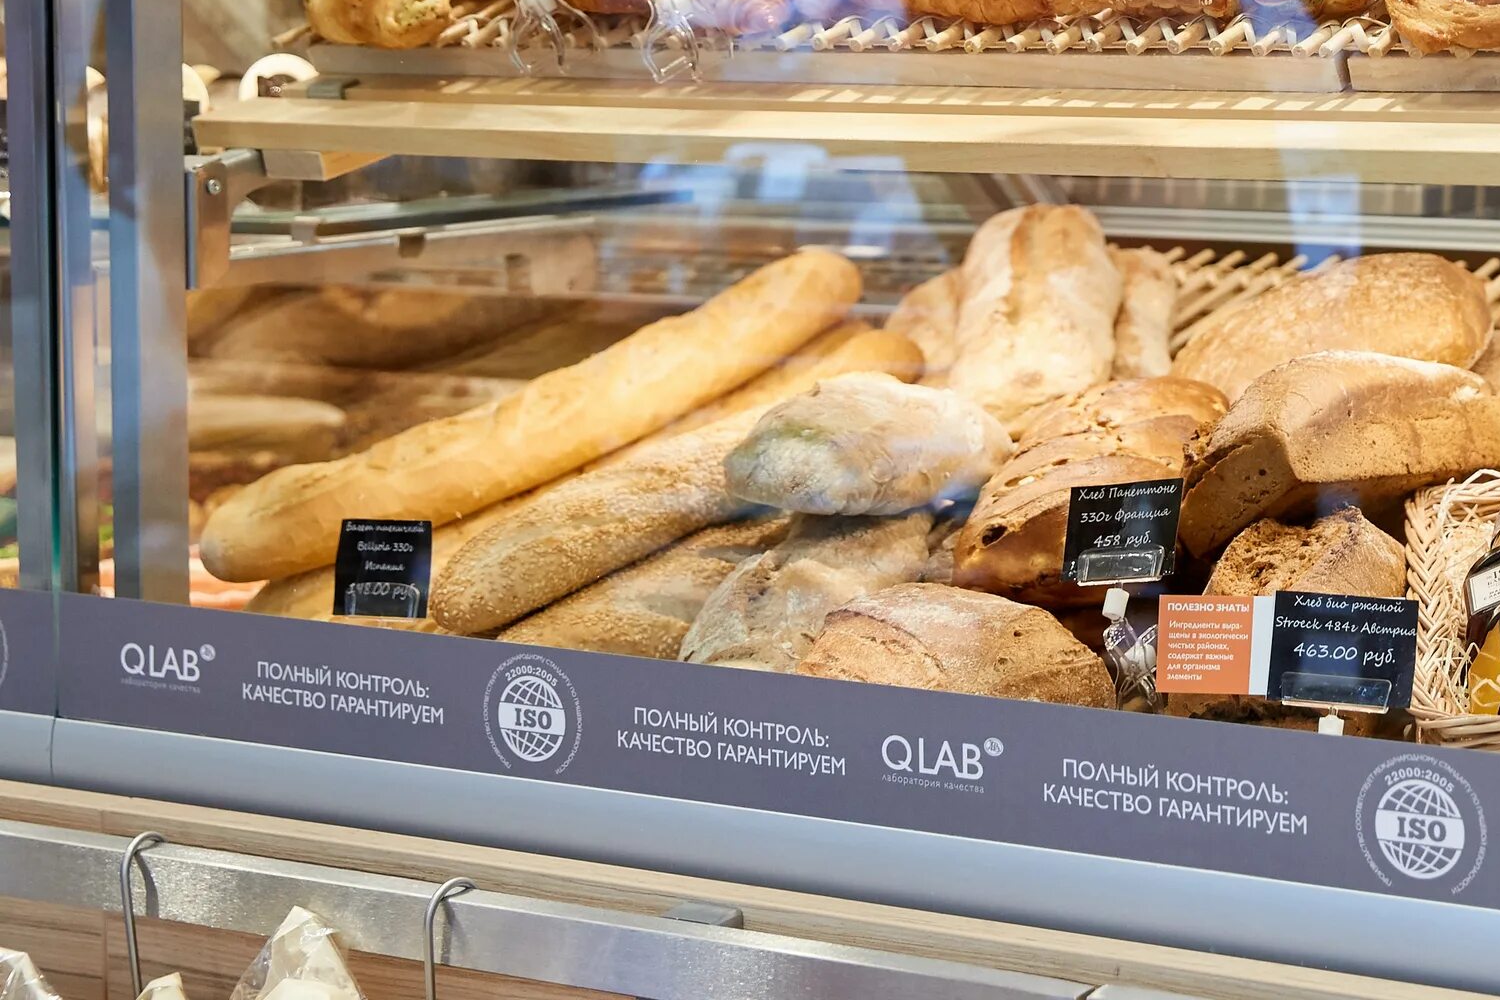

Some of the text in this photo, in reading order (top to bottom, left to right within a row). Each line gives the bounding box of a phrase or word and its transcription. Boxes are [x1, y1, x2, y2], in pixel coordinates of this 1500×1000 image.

[1078, 484, 1178, 501] Хлеб Панеттоне
[1080, 506, 1172, 523] 330г Франция
[1093, 530, 1152, 548] 458 руб.
[1167, 602, 1250, 613] ПОЛЕЗНО ЗНАТЬ!
[1294, 594, 1406, 615] Хлеб био ржаной
[1168, 632, 1190, 641] щены
[1198, 632, 1249, 641] экологически
[1169, 620, 1221, 631] Ингредиенты
[1275, 616, 1417, 639] Stroeck 484г Австрия
[1167, 642, 1196, 650] чистых
[1293, 641, 1396, 668] 463.00 руб.
[120, 642, 201, 682] QLAB
[1167, 653, 1235, 662] содержат важные
[1167, 663, 1221, 673] для организма
[256, 660, 430, 699] ПОЛНЫЙ КОНТРОЛЬ:
[505, 665, 559, 687] 22000:2005
[1166, 673, 1203, 682] элементы
[242, 683, 445, 725] КАЧЕСТВО ГАРАНТИРУЕМ
[514, 707, 553, 730] ISO
[633, 706, 830, 749] ПОЛНЫЙ КОНТРОЛЬ:
[616, 730, 846, 776] КАЧЕСТВО ГАРАНТИРУЕМ
[881, 734, 984, 780] QLAB
[881, 772, 985, 794] лаборатория качества
[1062, 758, 1289, 806] ПОЛНЫЙ КОНТРОЛЬ:
[1384, 767, 1455, 793] 22000:2005
[1042, 783, 1308, 836] КАЧЕСТВО ГАРАНТИРУЕМ
[1396, 815, 1447, 843] ISO
